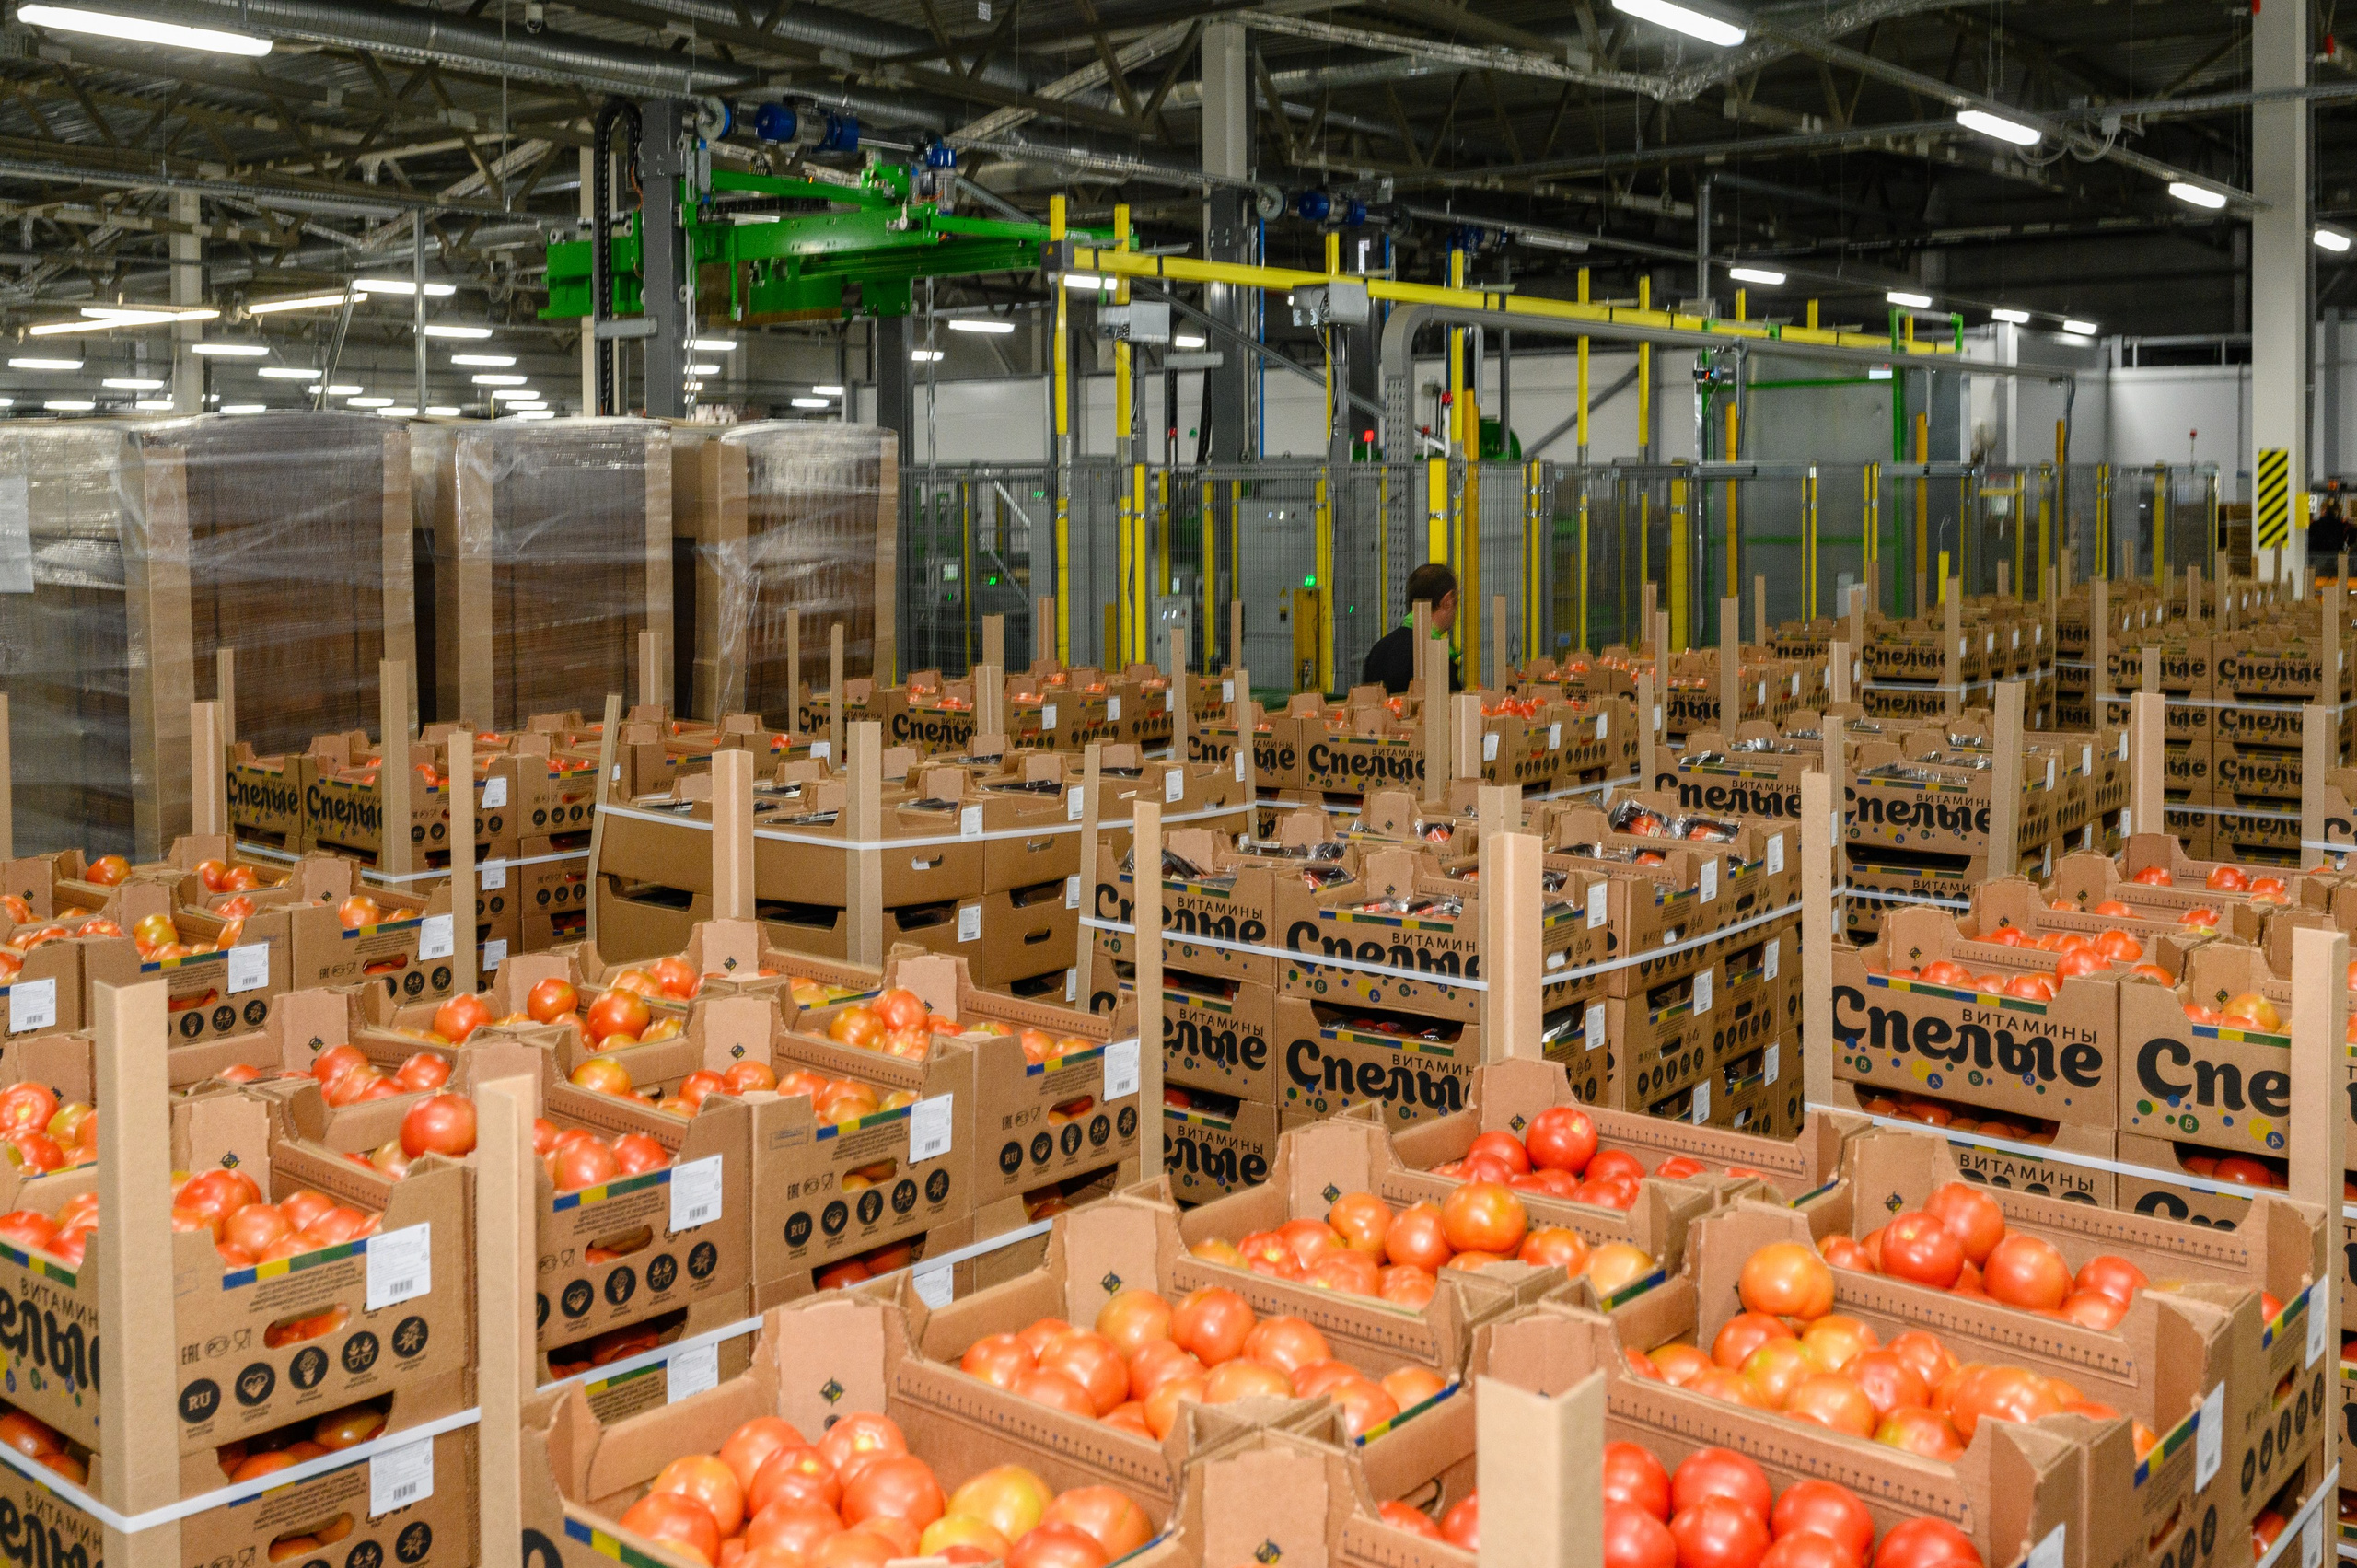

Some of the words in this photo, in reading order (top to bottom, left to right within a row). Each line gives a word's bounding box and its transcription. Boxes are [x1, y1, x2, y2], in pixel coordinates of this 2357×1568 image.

[1673, 694, 1720, 703] ВИТАМИН
[892, 714, 977, 745] Спелы
[1253, 739, 1294, 749] ТАМИНЫ
[1372, 748, 1426, 759] ВИТАМИН
[227, 772, 299, 816] Спелые
[1913, 879, 1971, 892] ВИТАМИ
[1178, 897, 1263, 920] ВИТАМИНЫ
[1392, 933, 1476, 953] ВИТАМИН
[1179, 1009, 1263, 1037] ВИТАМИНЫ
[1832, 985, 2103, 1088] Спелые
[1962, 1008, 2096, 1044] ВИТАМИНЫ
[1286, 1039, 1473, 1112] Спелы
[1392, 1054, 1474, 1076] ВИТАМИН
[2137, 1038, 2290, 1117] Спе
[1178, 1125, 1263, 1155] ВИТАМИНЫ
[1960, 1154, 2094, 1192] ВИТАМИНЫ
[21, 1276, 99, 1330] ВИТАМИН
[187, 1391, 212, 1412] RU
[25, 1490, 102, 1554] ВИТАМИН
